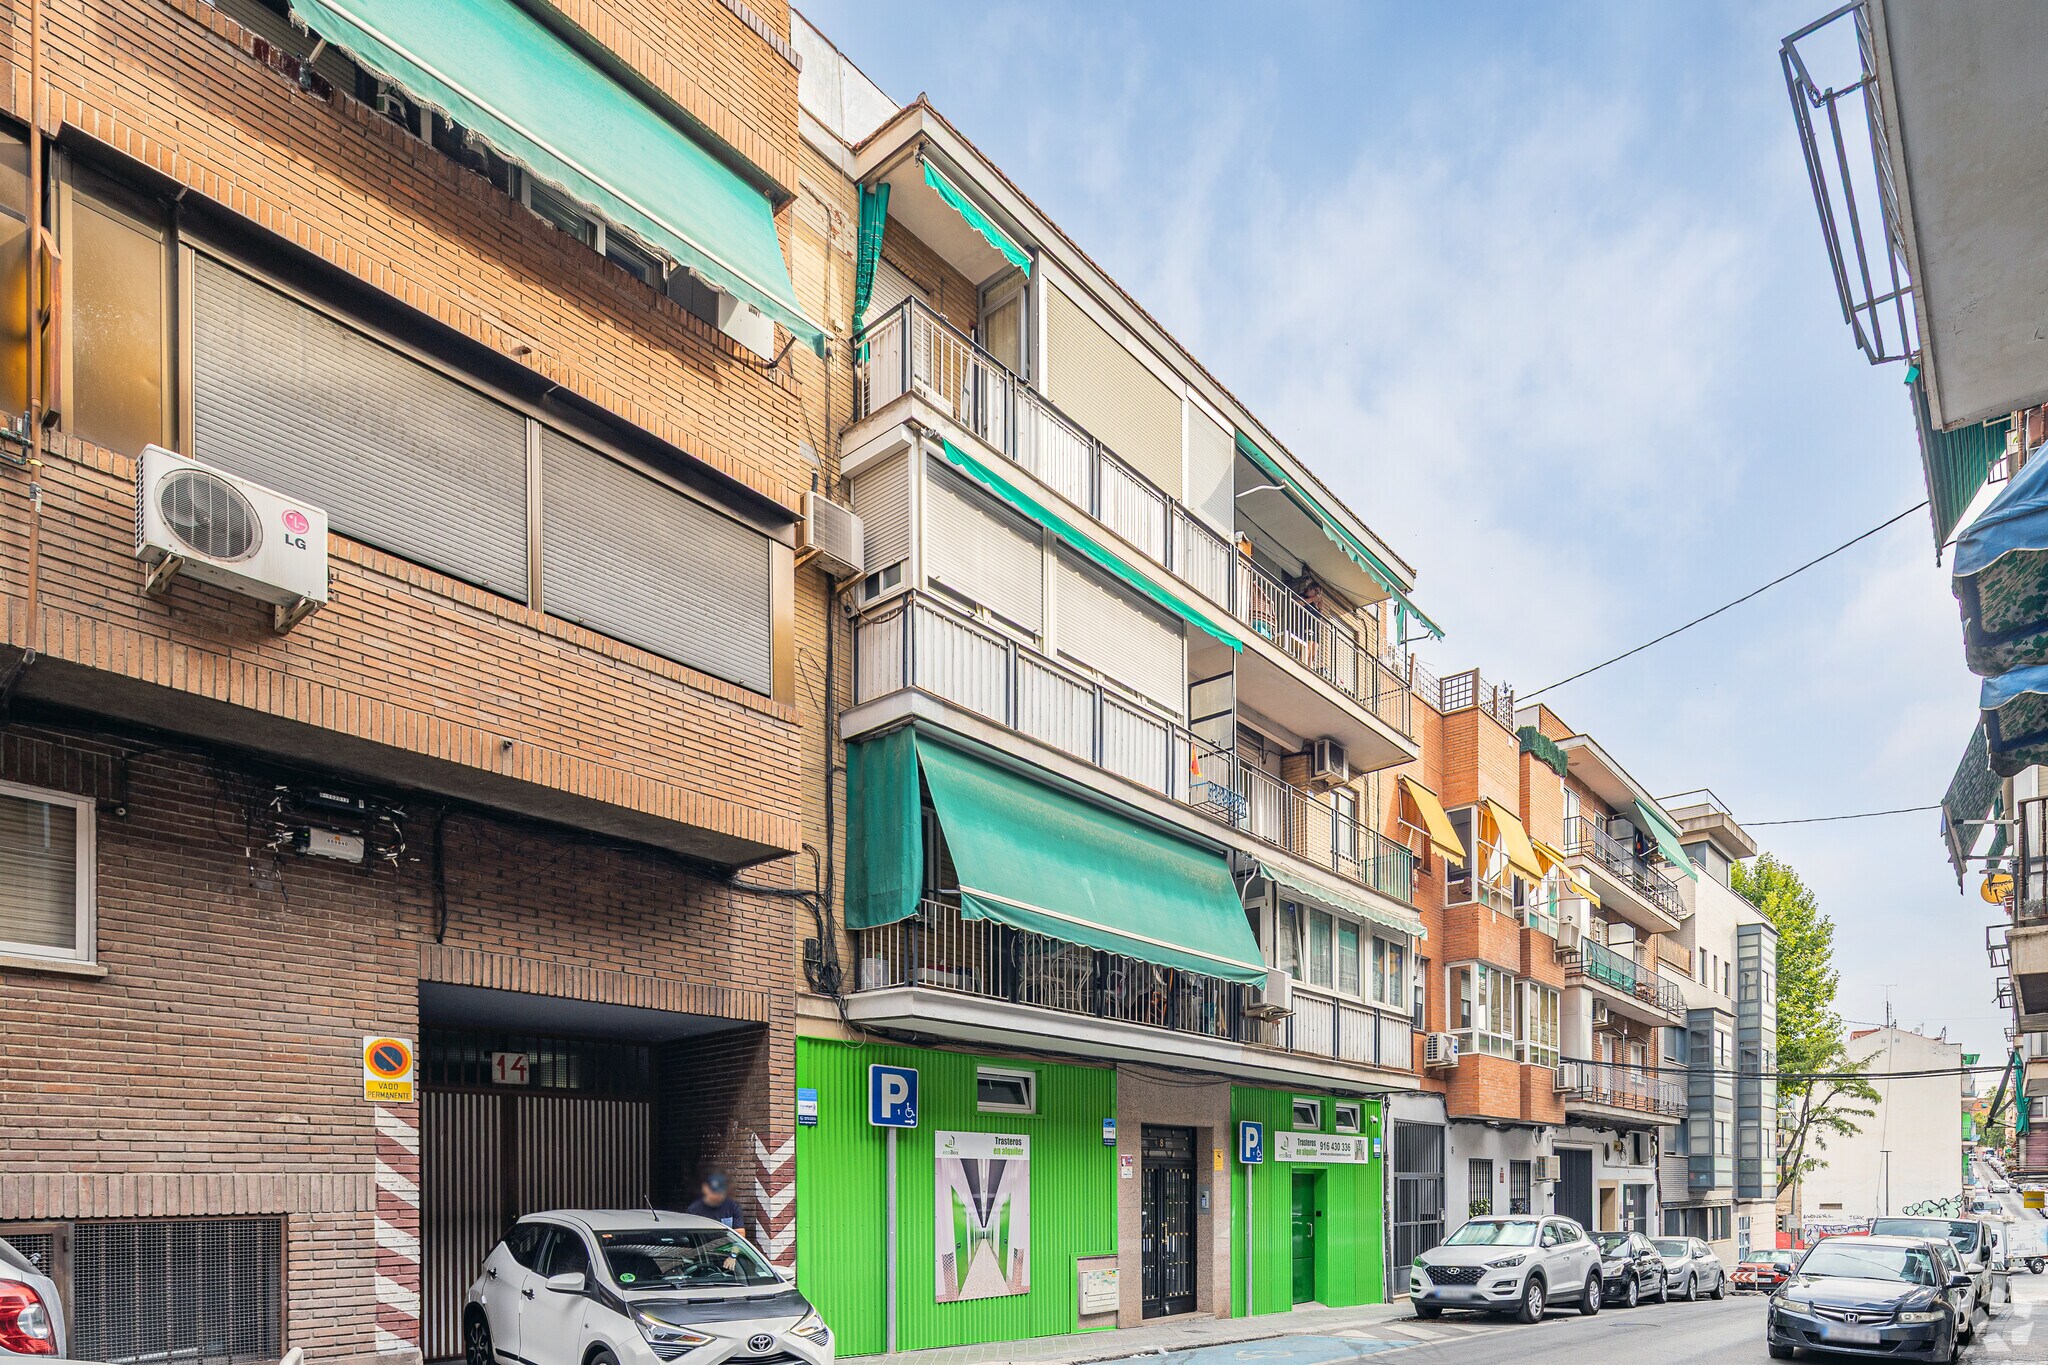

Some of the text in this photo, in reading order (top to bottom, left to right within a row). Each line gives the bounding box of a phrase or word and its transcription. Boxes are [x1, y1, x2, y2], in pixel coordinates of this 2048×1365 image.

[285, 533, 307, 551] LG
[496, 1054, 527, 1082] 14
[378, 1082, 399, 1090] VADO
[367, 1090, 411, 1100] PERMANENTE
[881, 1073, 909, 1118] P
[994, 1136, 1023, 1146] Trasteros
[1159, 1138, 1164, 1148] 8
[1245, 1126, 1258, 1157] P
[1297, 1138, 1316, 1147] Trasteros
[1319, 1141, 1351, 1152] 916 430 336
[993, 1147, 1024, 1157] en alquiler
[1296, 1148, 1318, 1157] en alquiler
